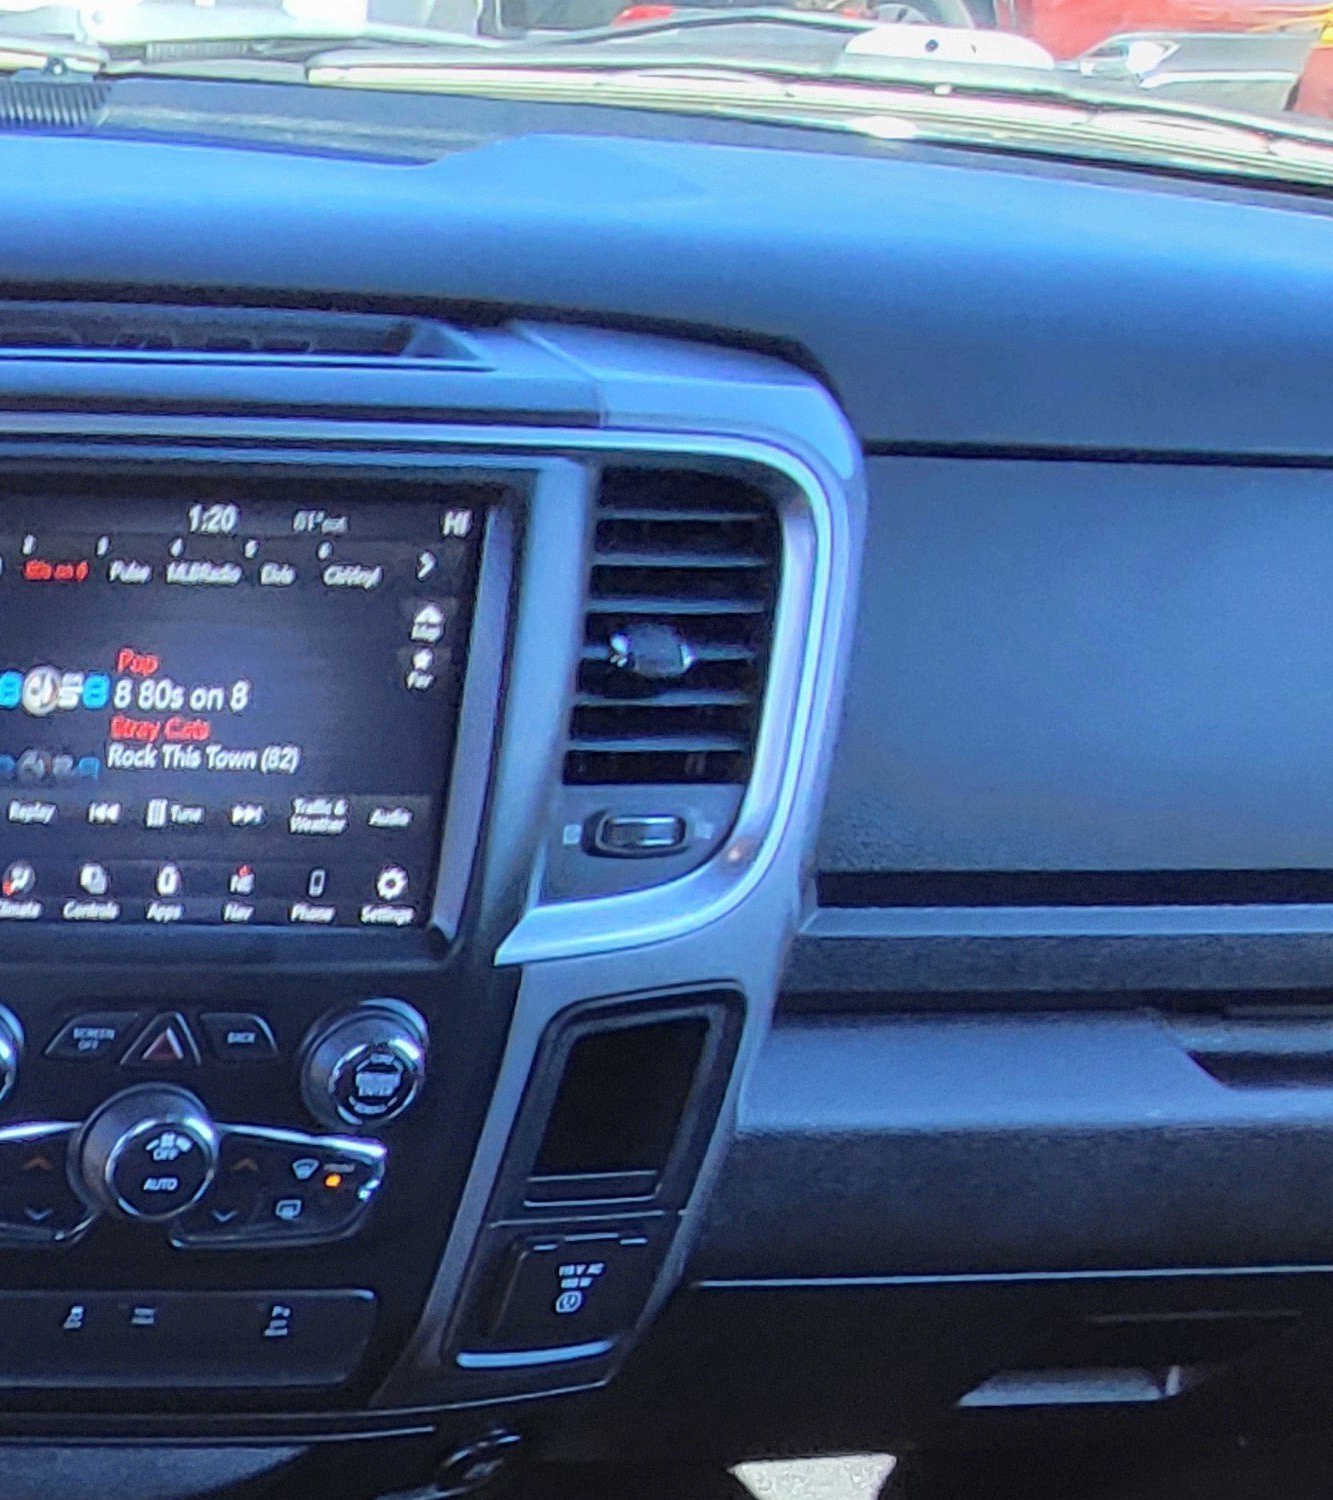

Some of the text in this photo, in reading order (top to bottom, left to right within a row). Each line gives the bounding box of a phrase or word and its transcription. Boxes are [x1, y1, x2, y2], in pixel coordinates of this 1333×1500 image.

[188, 503, 239, 533] 1:20
[117, 648, 160, 677] Pop
[112, 678, 250, 714] 8 80s on 8
[110, 715, 211, 743] Stray Cats
[106, 743, 300, 775] Rock This Town (82)
[8, 798, 58, 825] Replay
[170, 803, 205, 825] Tune
[367, 806, 413, 828] Audio
[62, 899, 121, 922] Controls
[146, 900, 183, 924] Apps
[223, 900, 255, 923] Nav
[290, 902, 336, 924] Phone
[360, 903, 416, 927] Settings
[73, 1027, 116, 1041] SCREEN
[77, 1038, 100, 1051] OFF
[227, 1031, 256, 1045] BACK
[153, 1148, 180, 1162] OFF
[143, 1177, 178, 1192] AUTO
